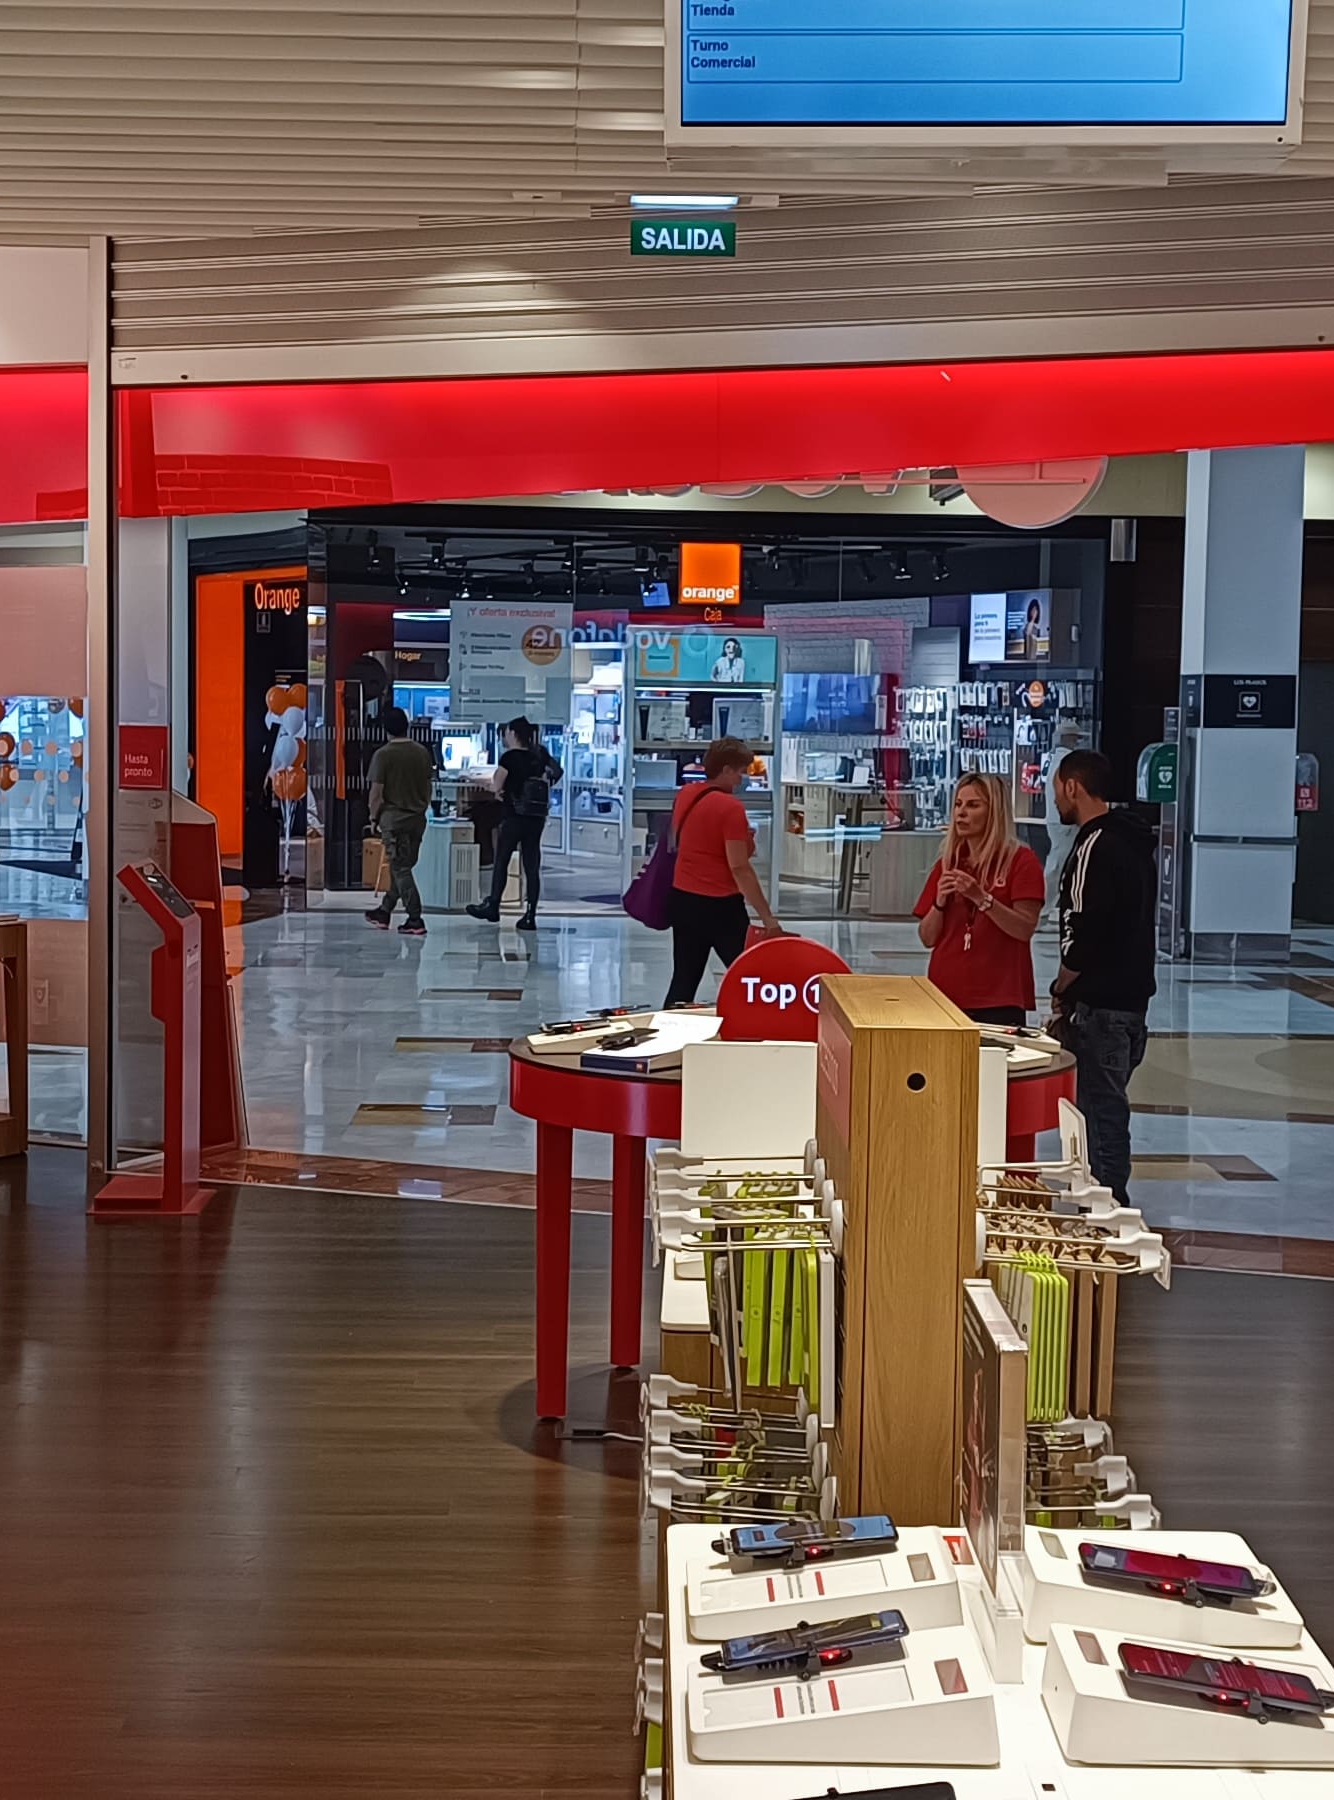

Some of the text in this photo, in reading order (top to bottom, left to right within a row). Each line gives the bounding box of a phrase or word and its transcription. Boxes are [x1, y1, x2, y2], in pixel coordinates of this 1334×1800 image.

[691, 4, 734, 16] Tienda
[691, 40, 729, 51] Turno
[691, 56, 756, 68] Comercial
[641, 227, 726, 250] SALIDA
[255, 583, 299, 615] Orange
[682, 587, 735, 602] orange
[704, 607, 722, 624] Caja
[394, 650, 422, 662] Hogar
[124, 753, 149, 764] Hasta
[124, 768, 153, 778] pronto
[740, 976, 820, 1010] Top 1
